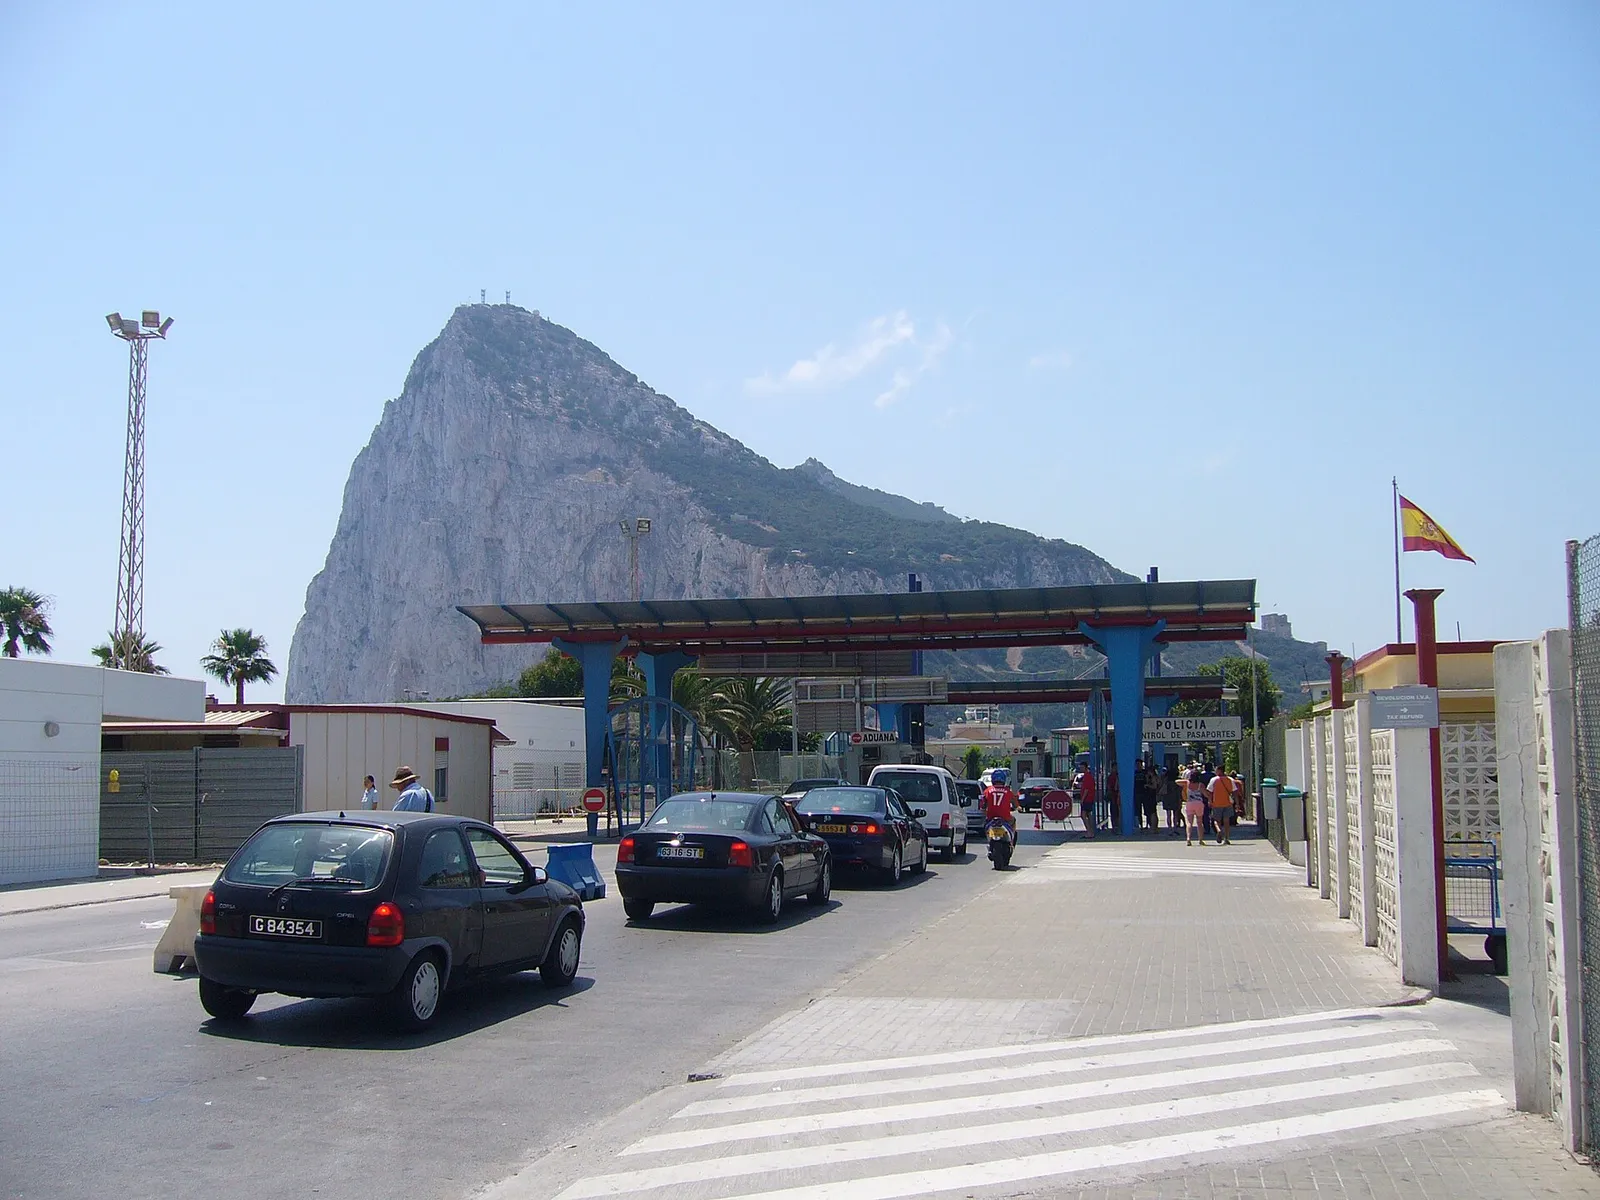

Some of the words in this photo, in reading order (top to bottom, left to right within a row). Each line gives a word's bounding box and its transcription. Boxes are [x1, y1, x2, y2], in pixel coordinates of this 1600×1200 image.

[1156, 720, 1206, 729] POLICIA
[863, 733, 895, 742] ADUANA
[1187, 730, 1236, 738] PASAPORTES
[992, 792, 1004, 806] 17
[1045, 801, 1070, 810] STOP
[255, 918, 264, 932] G
[267, 919, 314, 936] 84354
